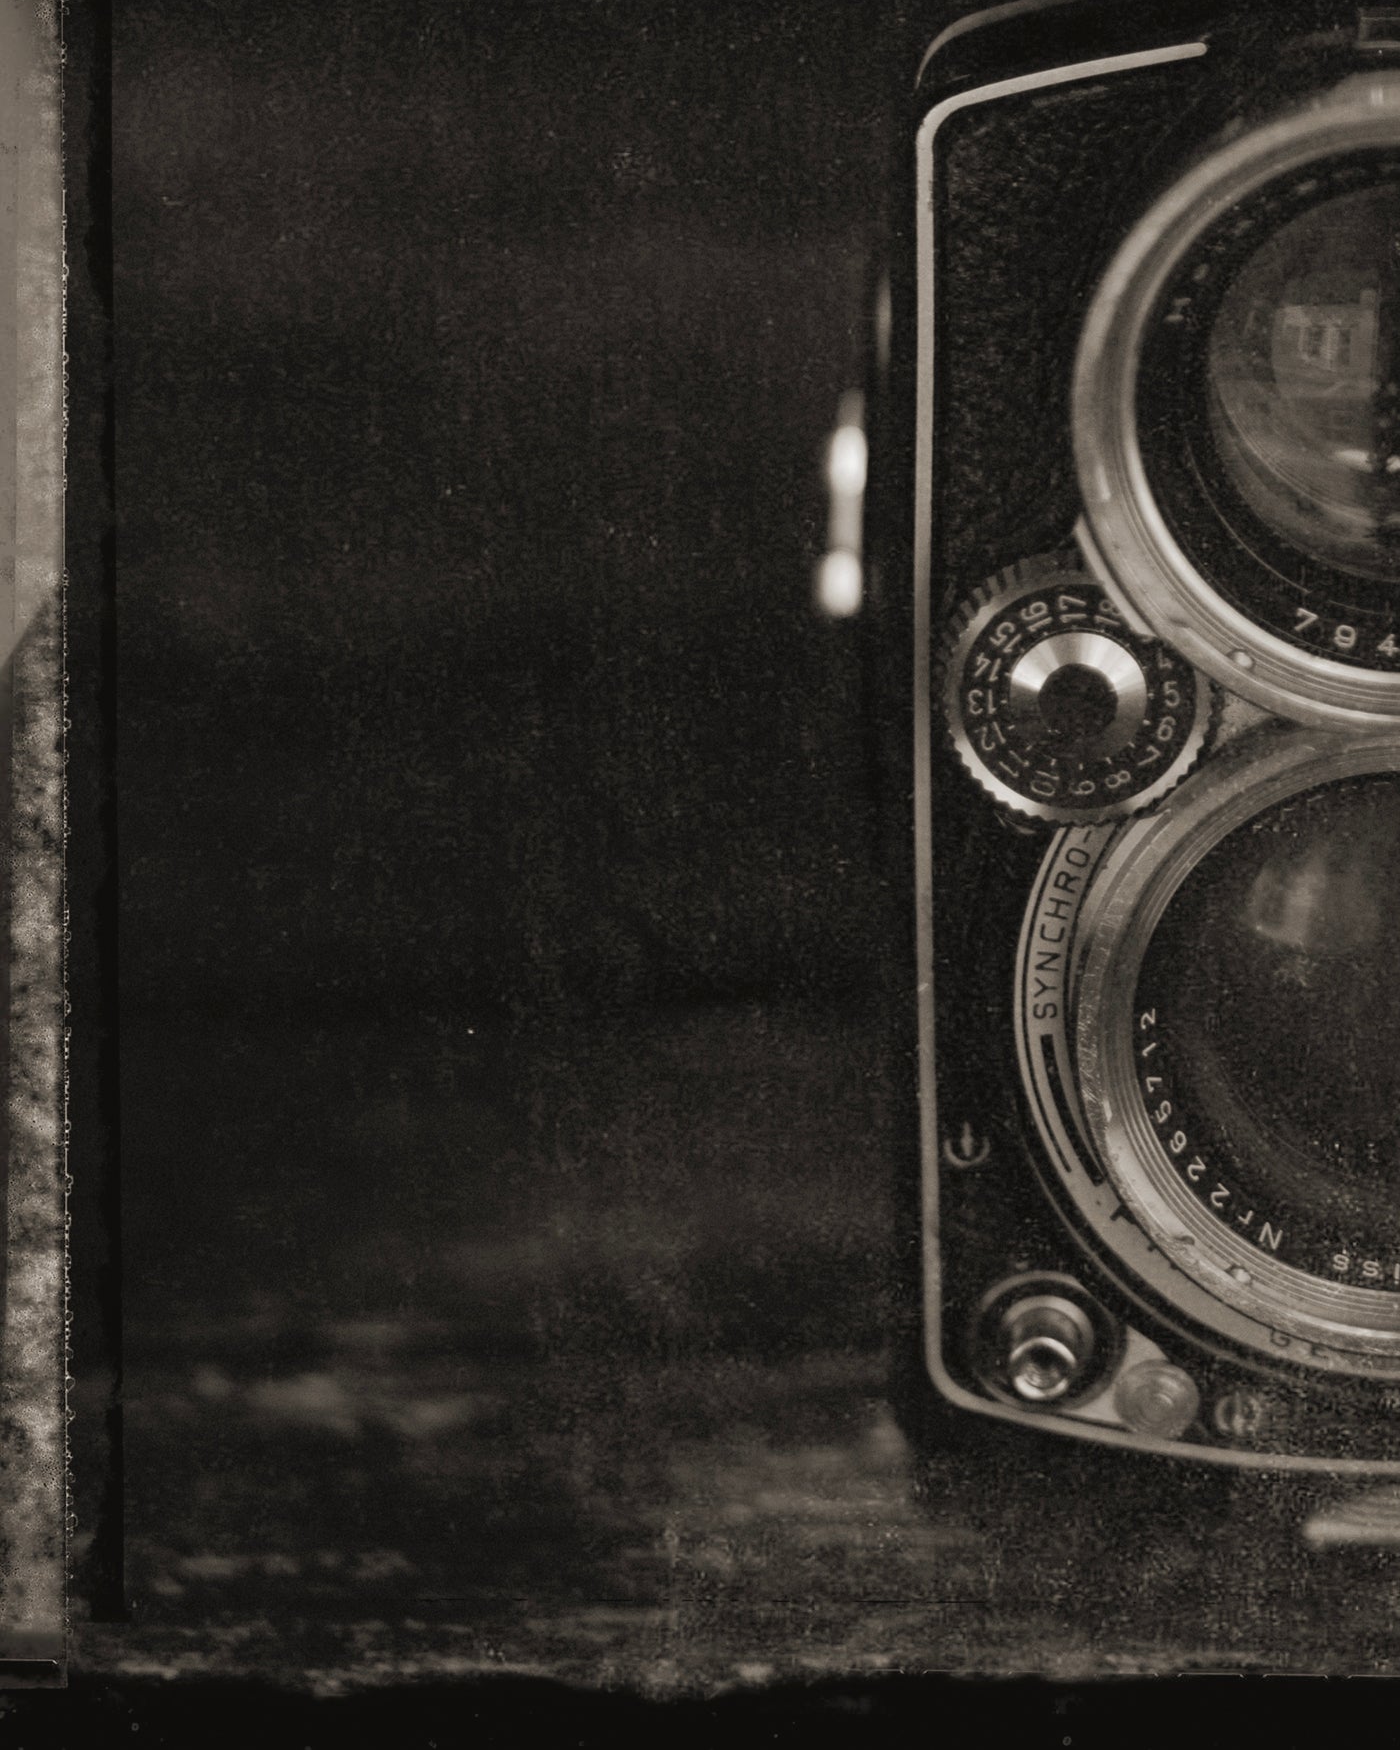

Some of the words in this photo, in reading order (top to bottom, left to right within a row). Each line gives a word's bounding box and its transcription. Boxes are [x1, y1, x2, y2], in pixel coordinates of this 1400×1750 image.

[1019, 601, 1053, 633] 16
[1058, 595, 1088, 624] 17
[989, 621, 1022, 653] 15
[974, 652, 1000, 682] 14
[967, 688, 997, 715] 13
[1162, 680, 1181, 708] 5
[975, 721, 1007, 751] 12
[1157, 716, 1177, 741] 6
[998, 750, 1030, 778] 11
[1137, 745, 1161, 766] 7
[1029, 769, 1060, 797] 10
[1104, 769, 1132, 789] 8
[1238, 1210, 1284, 1250] Nr
